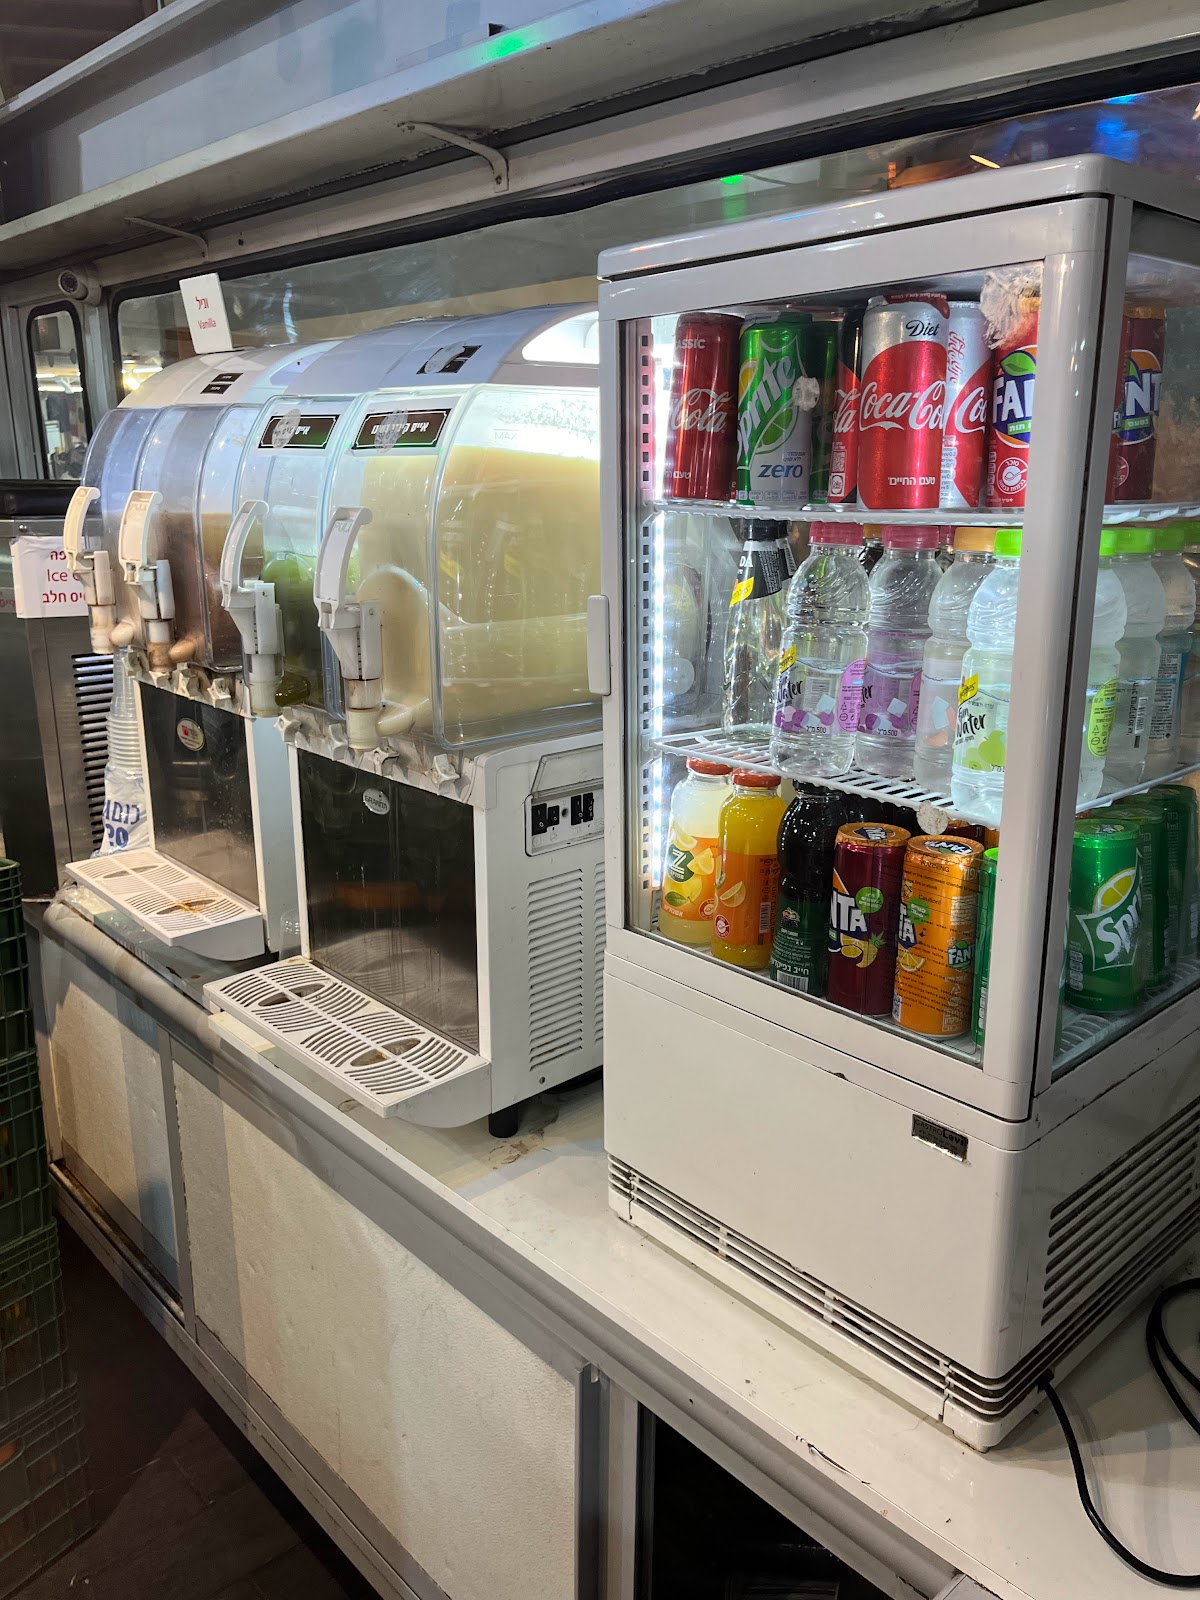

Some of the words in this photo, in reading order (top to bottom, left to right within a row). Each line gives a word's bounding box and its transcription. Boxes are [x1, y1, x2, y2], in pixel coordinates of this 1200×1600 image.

[198, 318, 217, 329] Vanilla
[905, 320, 939, 336] Diet
[494, 431, 518, 440] MAX
[1005, 459, 1020, 467] סוכר
[758, 464, 803, 478] zero
[918, 476, 936, 485] טעם
[47, 569, 68, 582] Ice
[42, 589, 67, 604] חלב
[816, 726, 827, 734] 500
[364, 795, 388, 810] GRANITA
[793, 966, 809, 976] חייב
